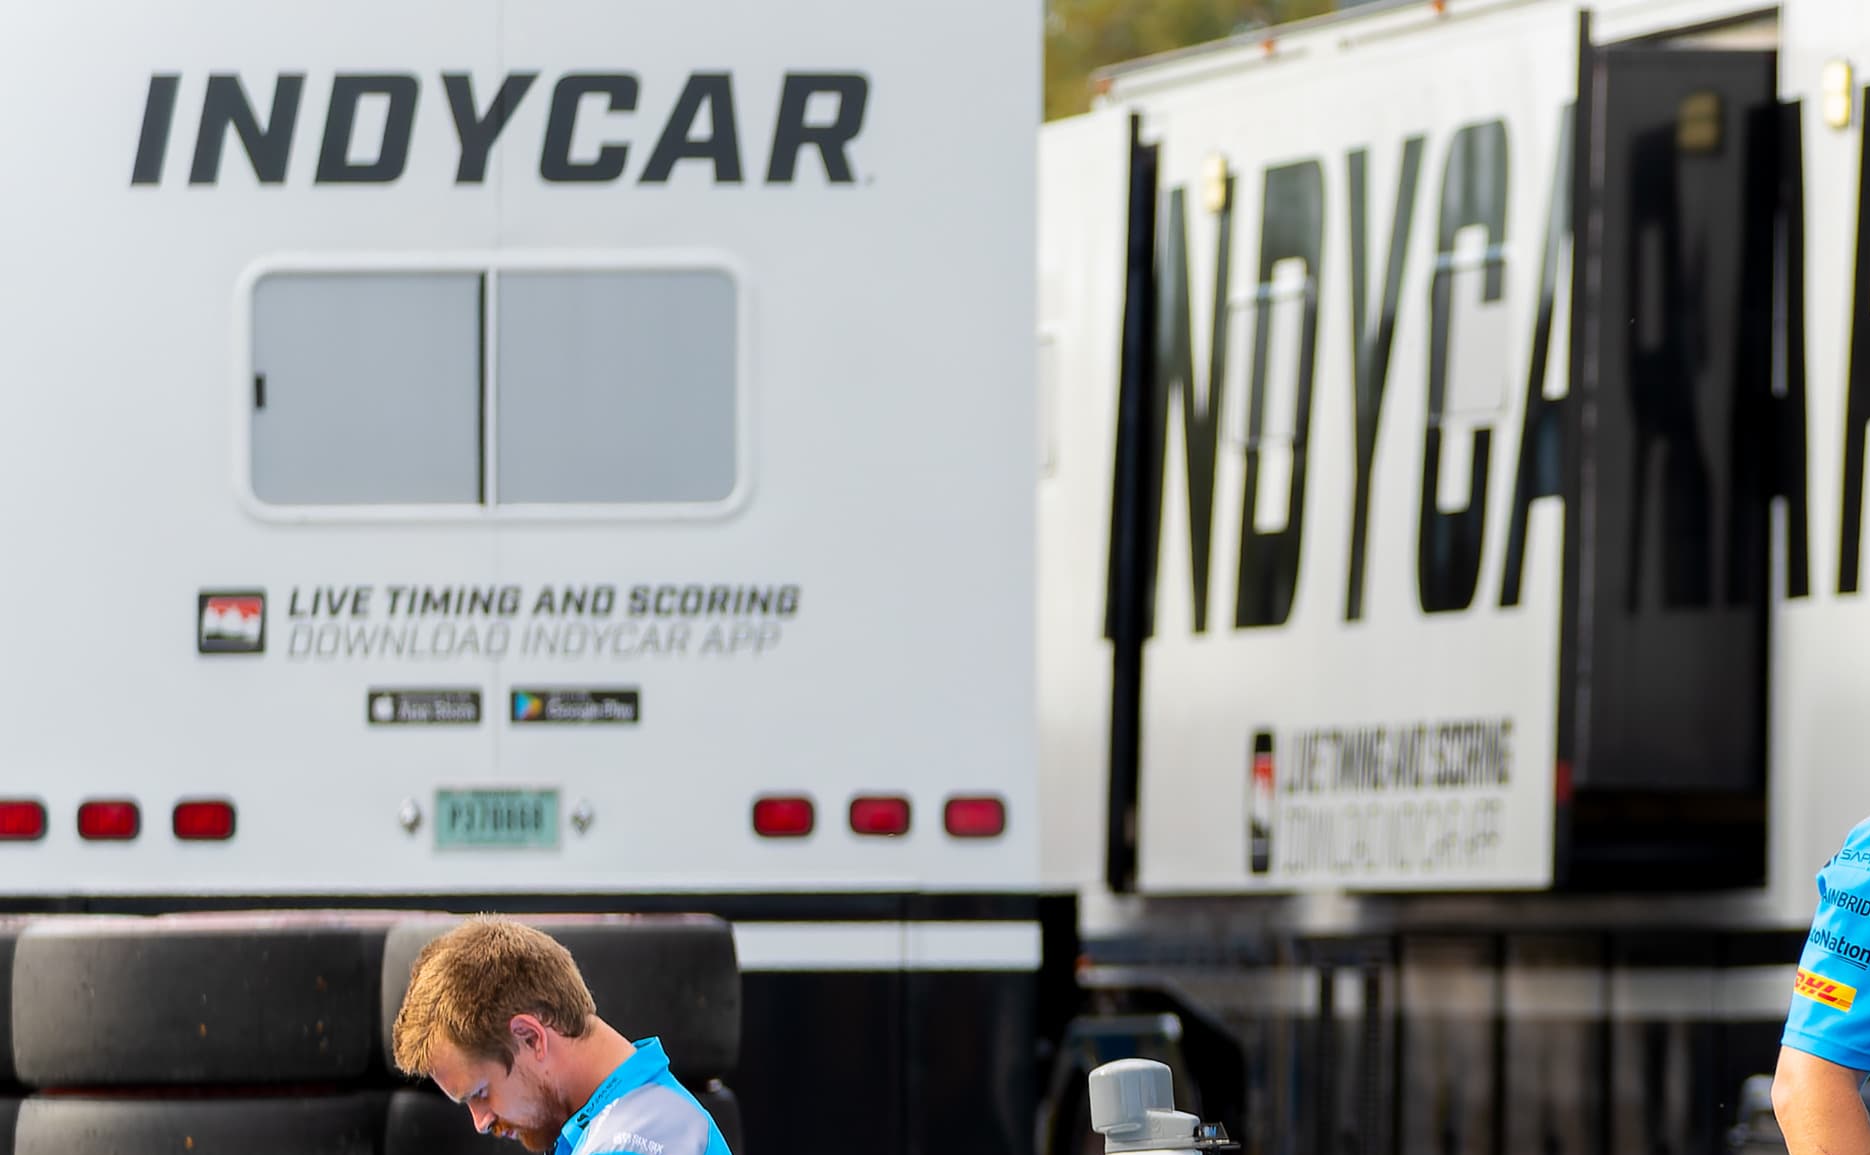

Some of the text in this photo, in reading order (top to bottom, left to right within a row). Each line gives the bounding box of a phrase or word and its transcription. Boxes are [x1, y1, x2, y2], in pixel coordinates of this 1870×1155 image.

[128, 70, 870, 188] INDYCAR
[287, 583, 804, 619] LIVE TIMING AND SCORING
